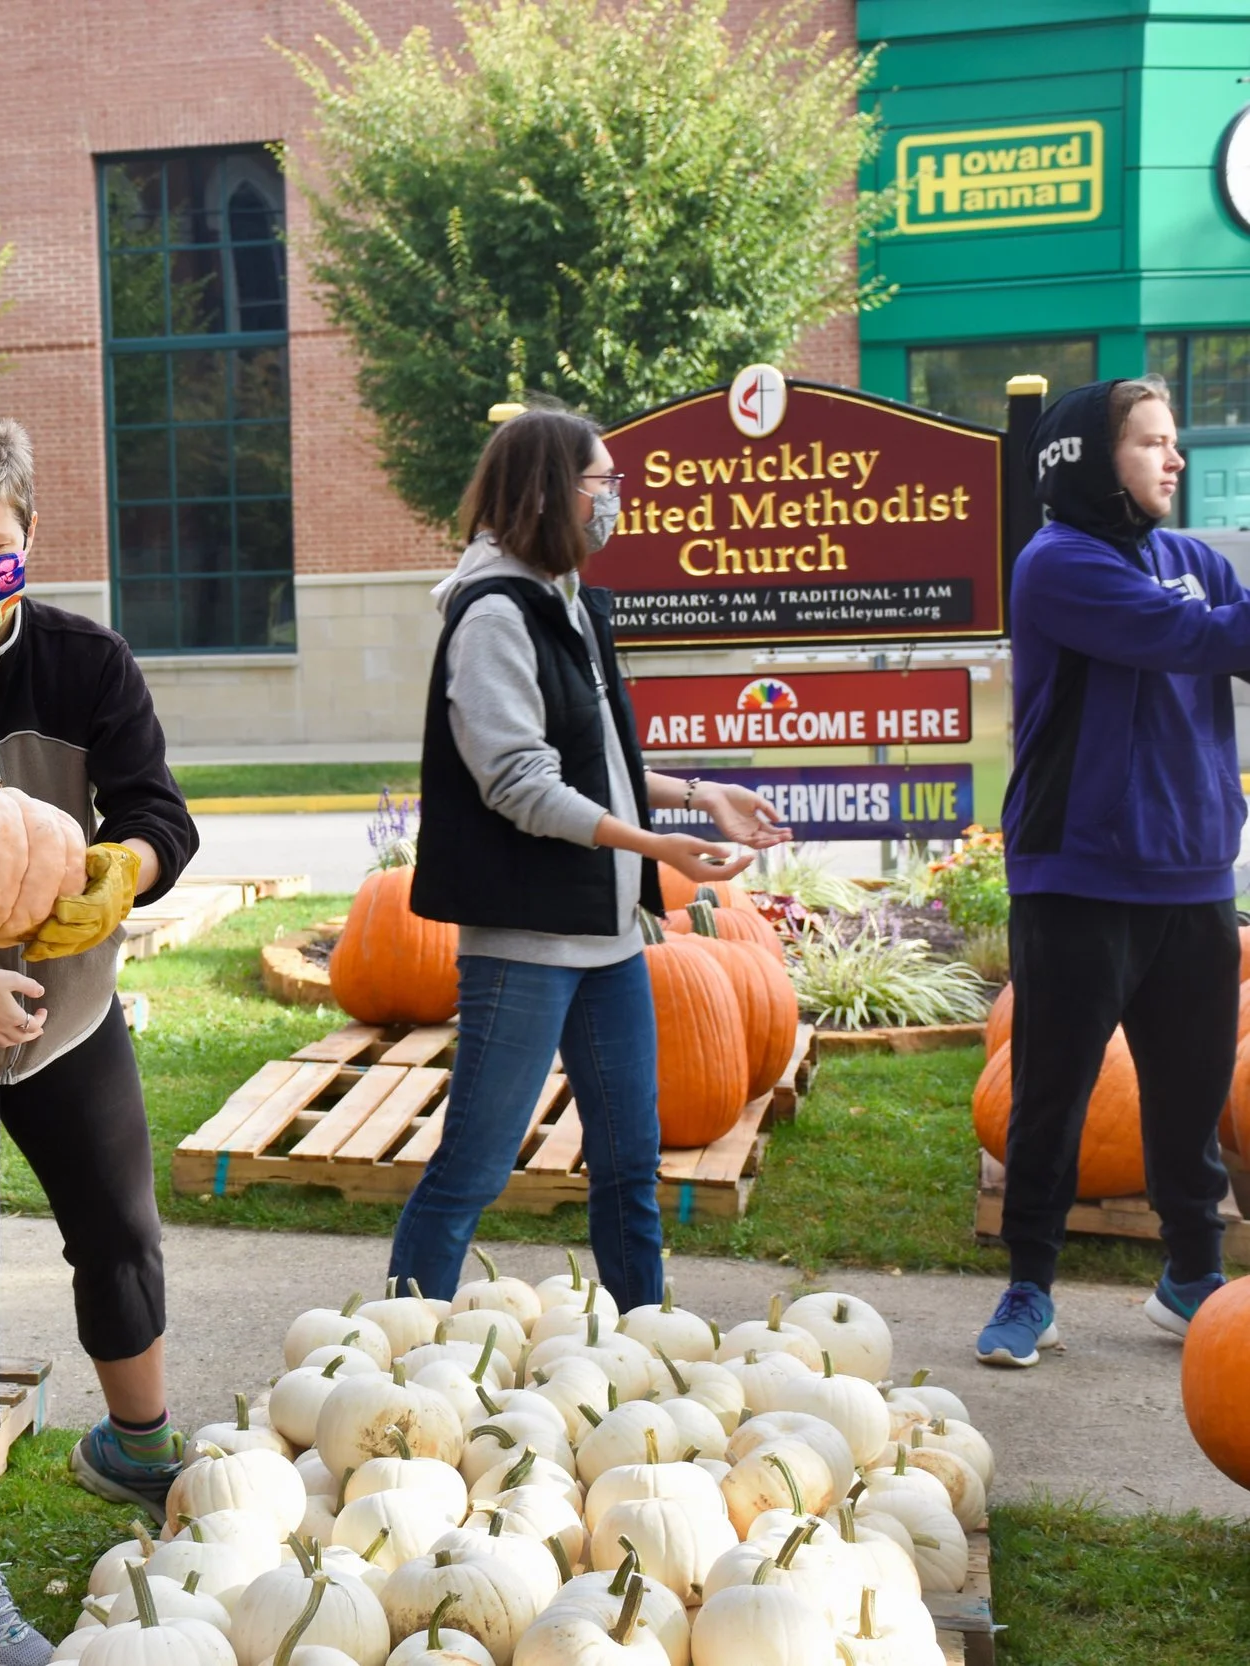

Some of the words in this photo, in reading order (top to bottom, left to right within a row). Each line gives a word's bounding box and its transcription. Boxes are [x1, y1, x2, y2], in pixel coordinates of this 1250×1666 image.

[918, 135, 1081, 215] Howard
[644, 440, 880, 490] Sewickley
[610, 493, 715, 536] nited
[730, 482, 971, 531] Methodist
[679, 532, 849, 577] Church
[614, 594, 714, 609] TEMPORARY-
[718, 594, 728, 606] 9
[731, 592, 757, 605] AM
[779, 587, 898, 604] TRADITIONAL-
[902, 586, 920, 599] 11
[926, 585, 952, 599] AM
[651, 610, 725, 626] SCHOOL-
[730, 610, 748, 622] 10
[751, 609, 777, 622] AM
[796, 604, 942, 622] sewickleyumc.org
[646, 714, 706, 744] ARE
[715, 710, 866, 743] WELCOME
[876, 708, 960, 738] HERE
[900, 781, 958, 821] LIVE
